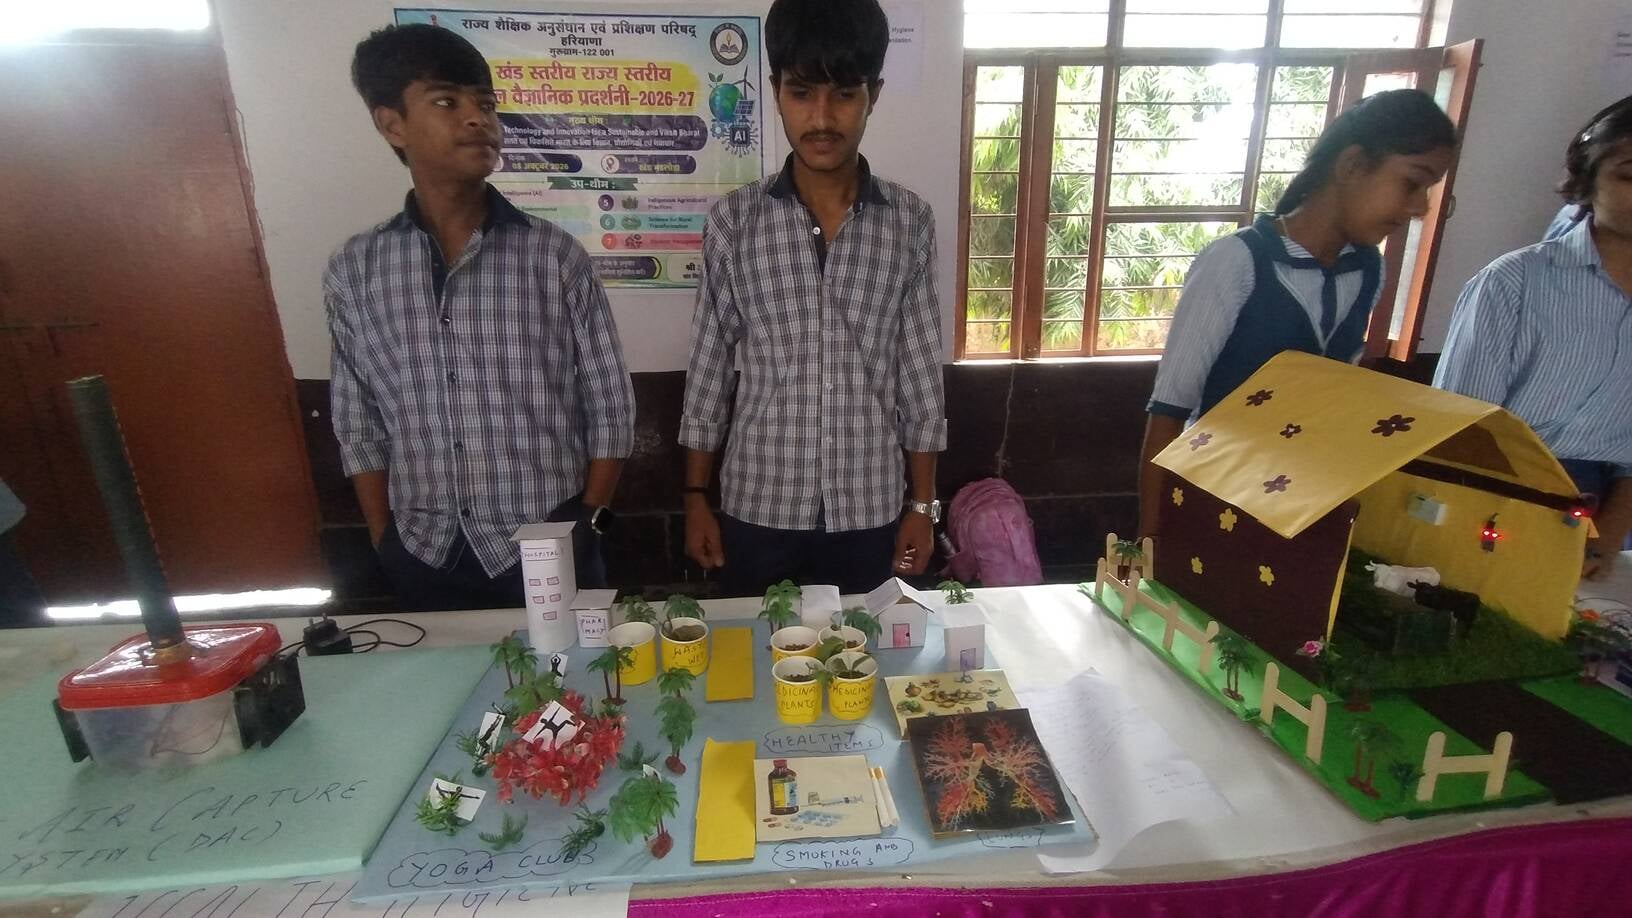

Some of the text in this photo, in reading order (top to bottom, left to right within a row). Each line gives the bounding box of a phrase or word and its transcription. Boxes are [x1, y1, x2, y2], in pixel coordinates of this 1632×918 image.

[461, 18, 490, 30] राज्य
[537, 18, 585, 36] अनुसंधान
[590, 20, 607, 34] एवं
[611, 20, 656, 35] प्रशिक्षण
[560, 34, 602, 46] हरियाणा
[495, 60, 672, 82] खंड स्तरीय राज्य स्तरीय
[511, 83, 574, 106] वैज्ञानिक
[577, 84, 695, 107] प्रदर्शनी-2026-27
[733, 130, 747, 141] AI
[570, 178, 609, 189] उप-थीम
[772, 730, 856, 748] HEALTHY
[829, 739, 873, 752] ITEMS
[18, 803, 136, 845] AIR
[785, 848, 862, 862] SMOKING
[410, 859, 494, 882] YOGA
[824, 857, 874, 870] DRUGS
